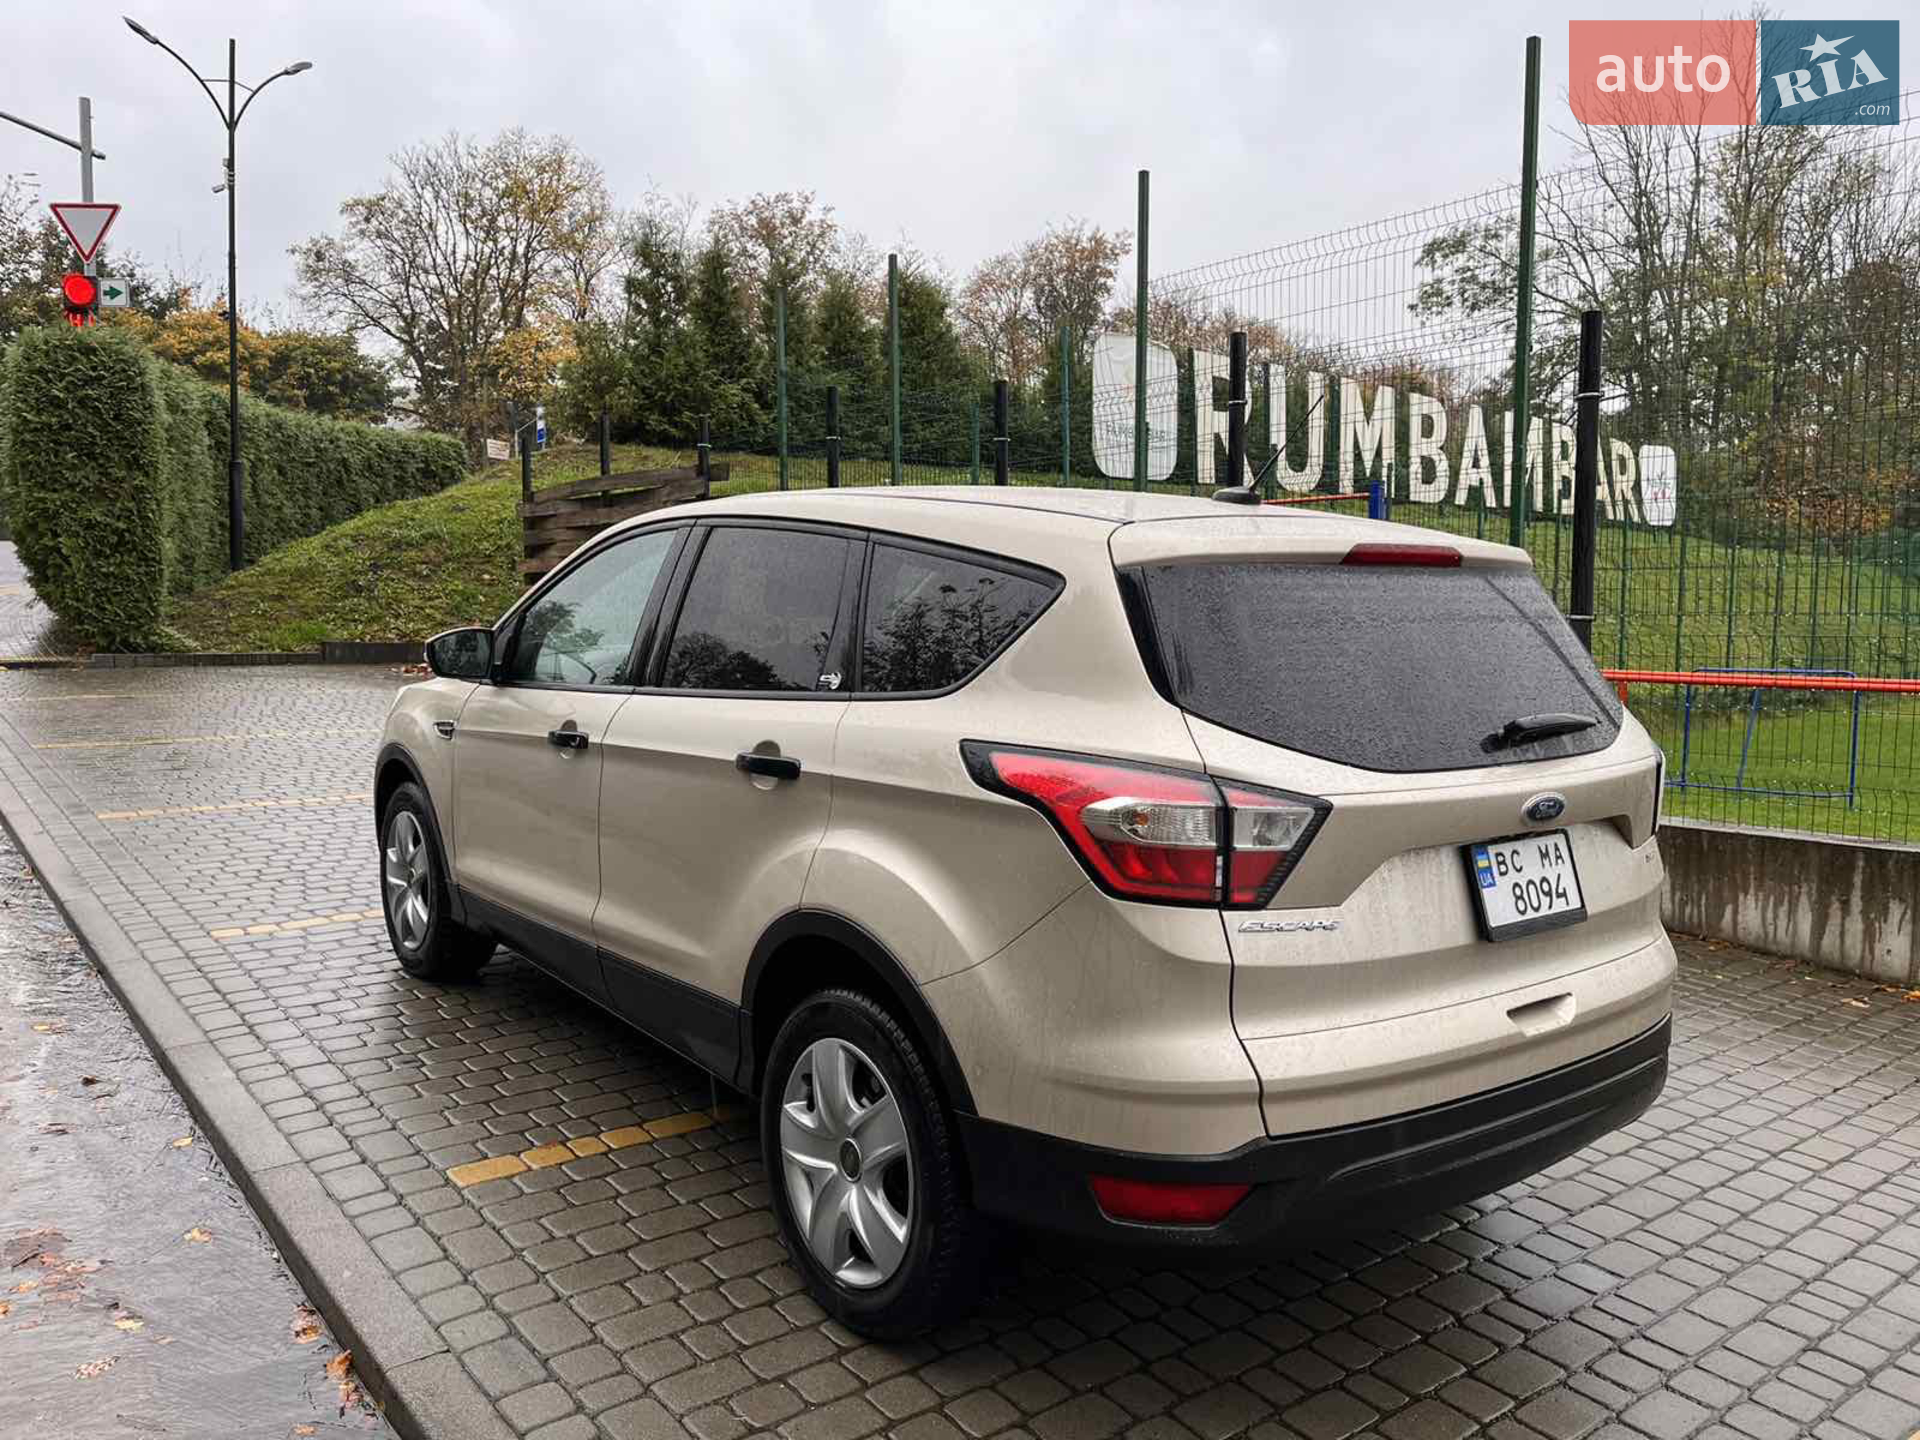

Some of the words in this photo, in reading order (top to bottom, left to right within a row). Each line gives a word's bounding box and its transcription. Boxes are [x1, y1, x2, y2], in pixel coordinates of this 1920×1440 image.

[1495, 850, 1523, 877] BC
[1537, 842, 1565, 868] MA
[1480, 873, 1494, 886] UA
[1512, 873, 1569, 915] 8094
